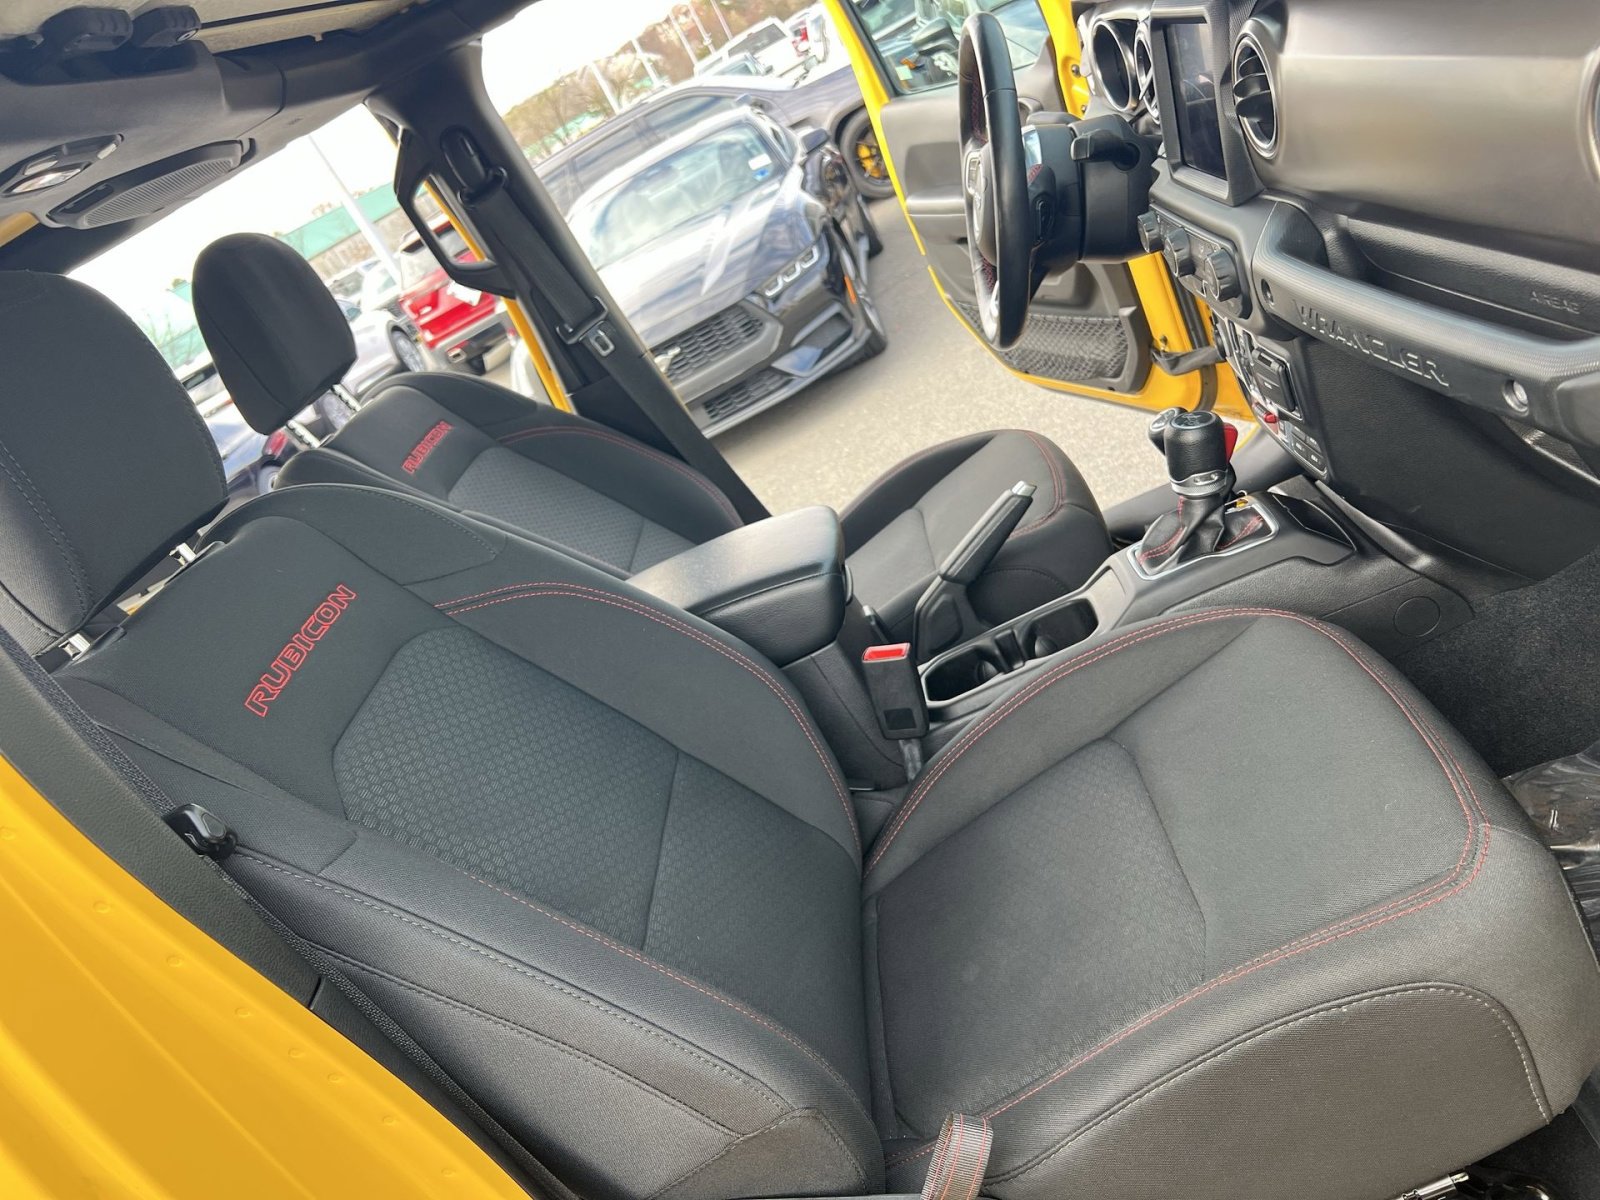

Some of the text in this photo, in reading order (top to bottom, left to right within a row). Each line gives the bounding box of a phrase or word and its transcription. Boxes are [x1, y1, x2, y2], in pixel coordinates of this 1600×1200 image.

[1294, 299, 1449, 387] WRANGLER
[401, 419, 453, 474] RUBICON
[244, 583, 357, 718] RUBICON
